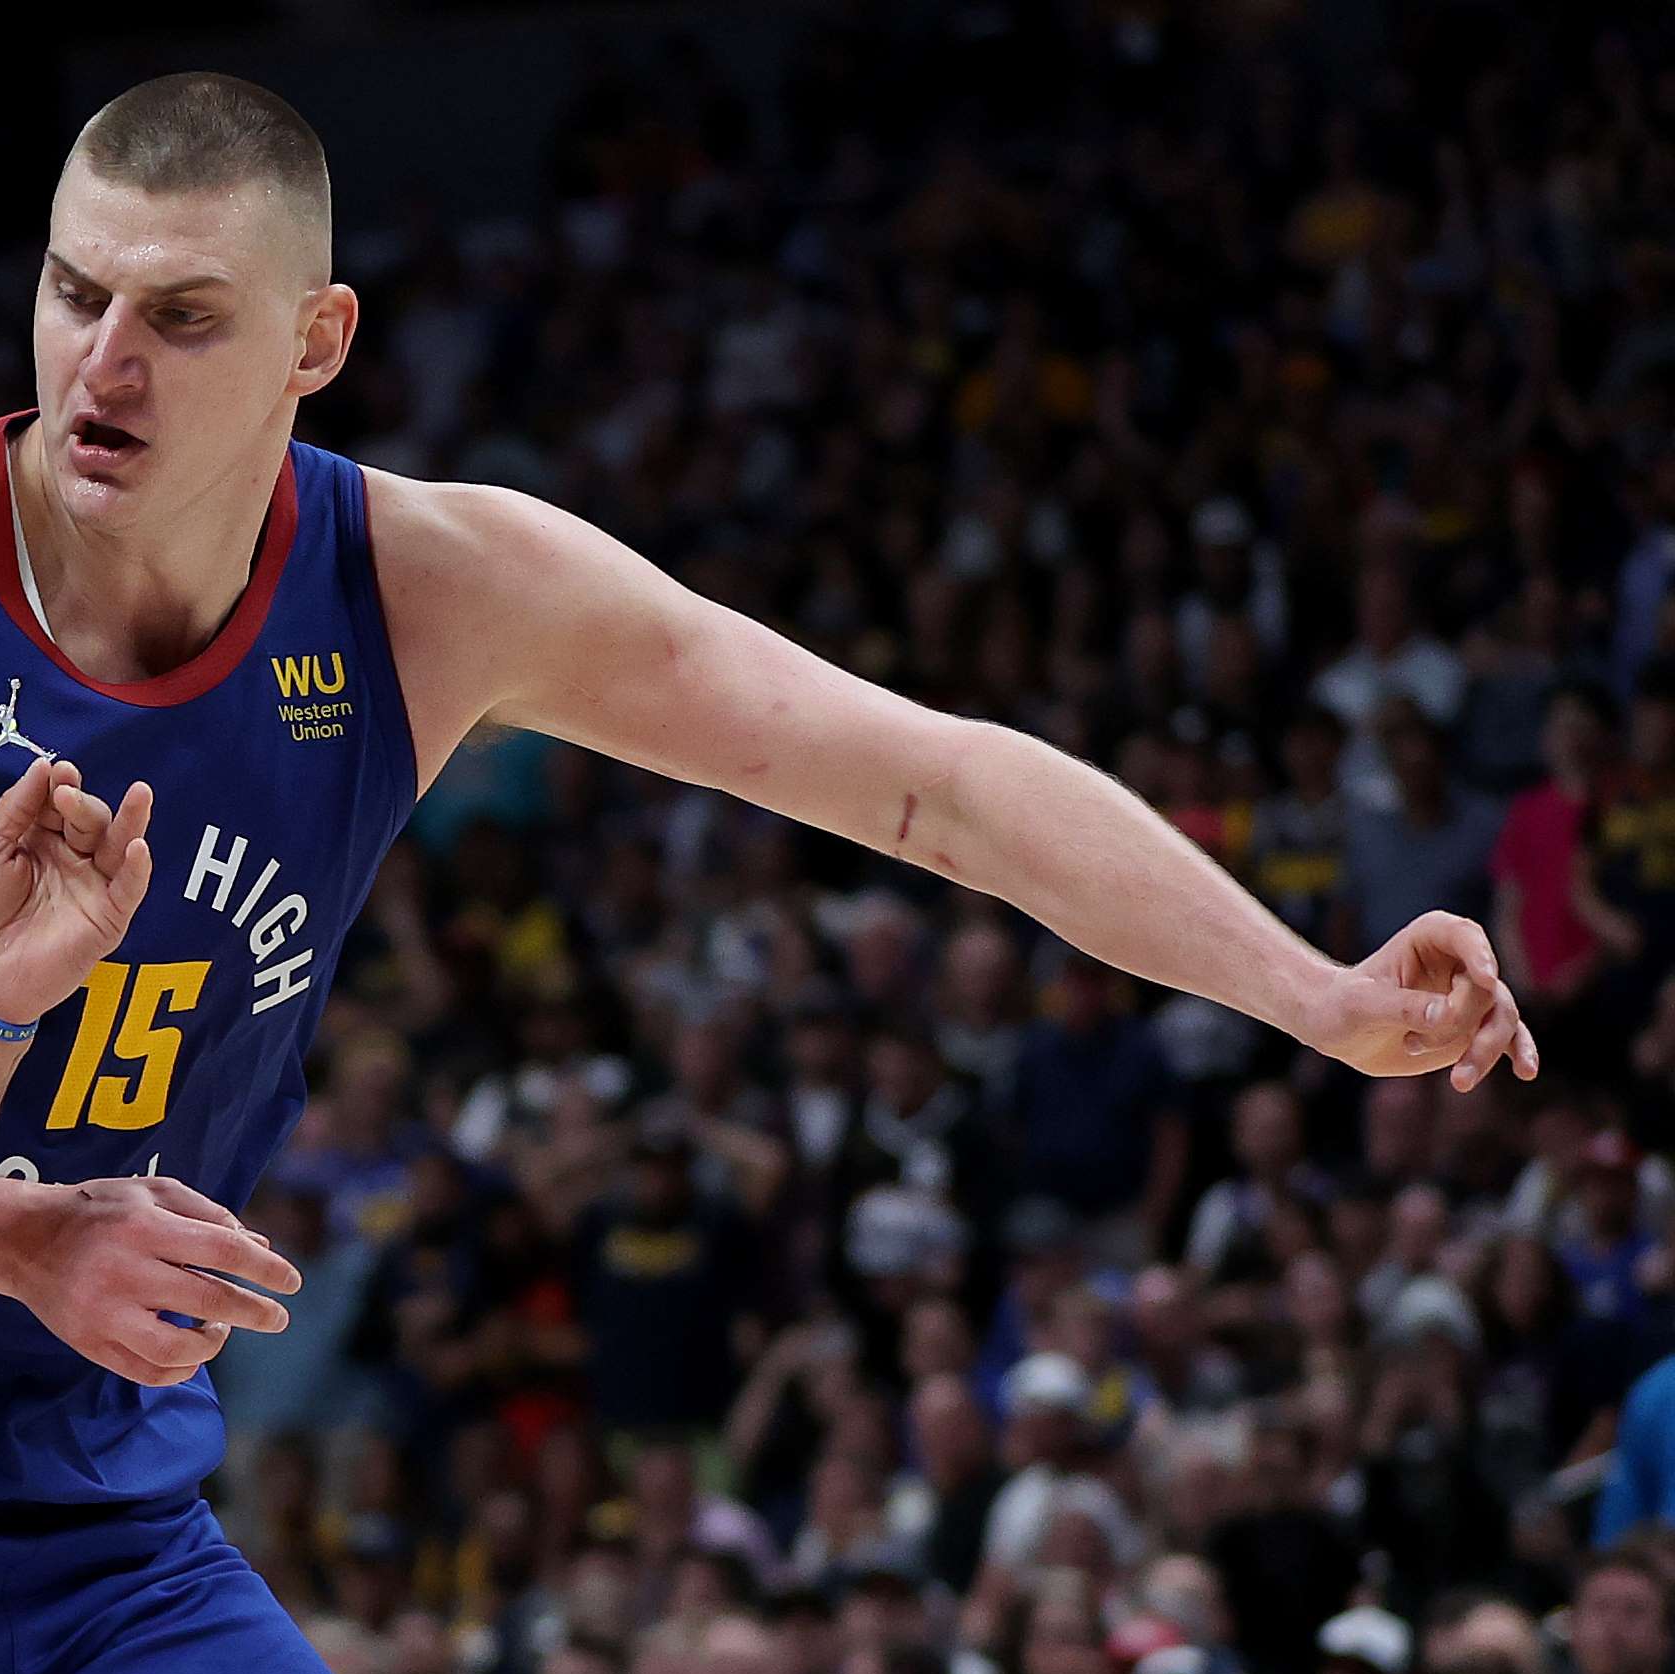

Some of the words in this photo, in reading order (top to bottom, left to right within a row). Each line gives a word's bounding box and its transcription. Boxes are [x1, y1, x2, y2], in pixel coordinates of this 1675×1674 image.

[271, 652, 345, 698] WU
[278, 702, 353, 722] Western
[291, 721, 344, 741] Union
[183, 824, 313, 1015] HIGH
[45, 960, 212, 1130] 15
